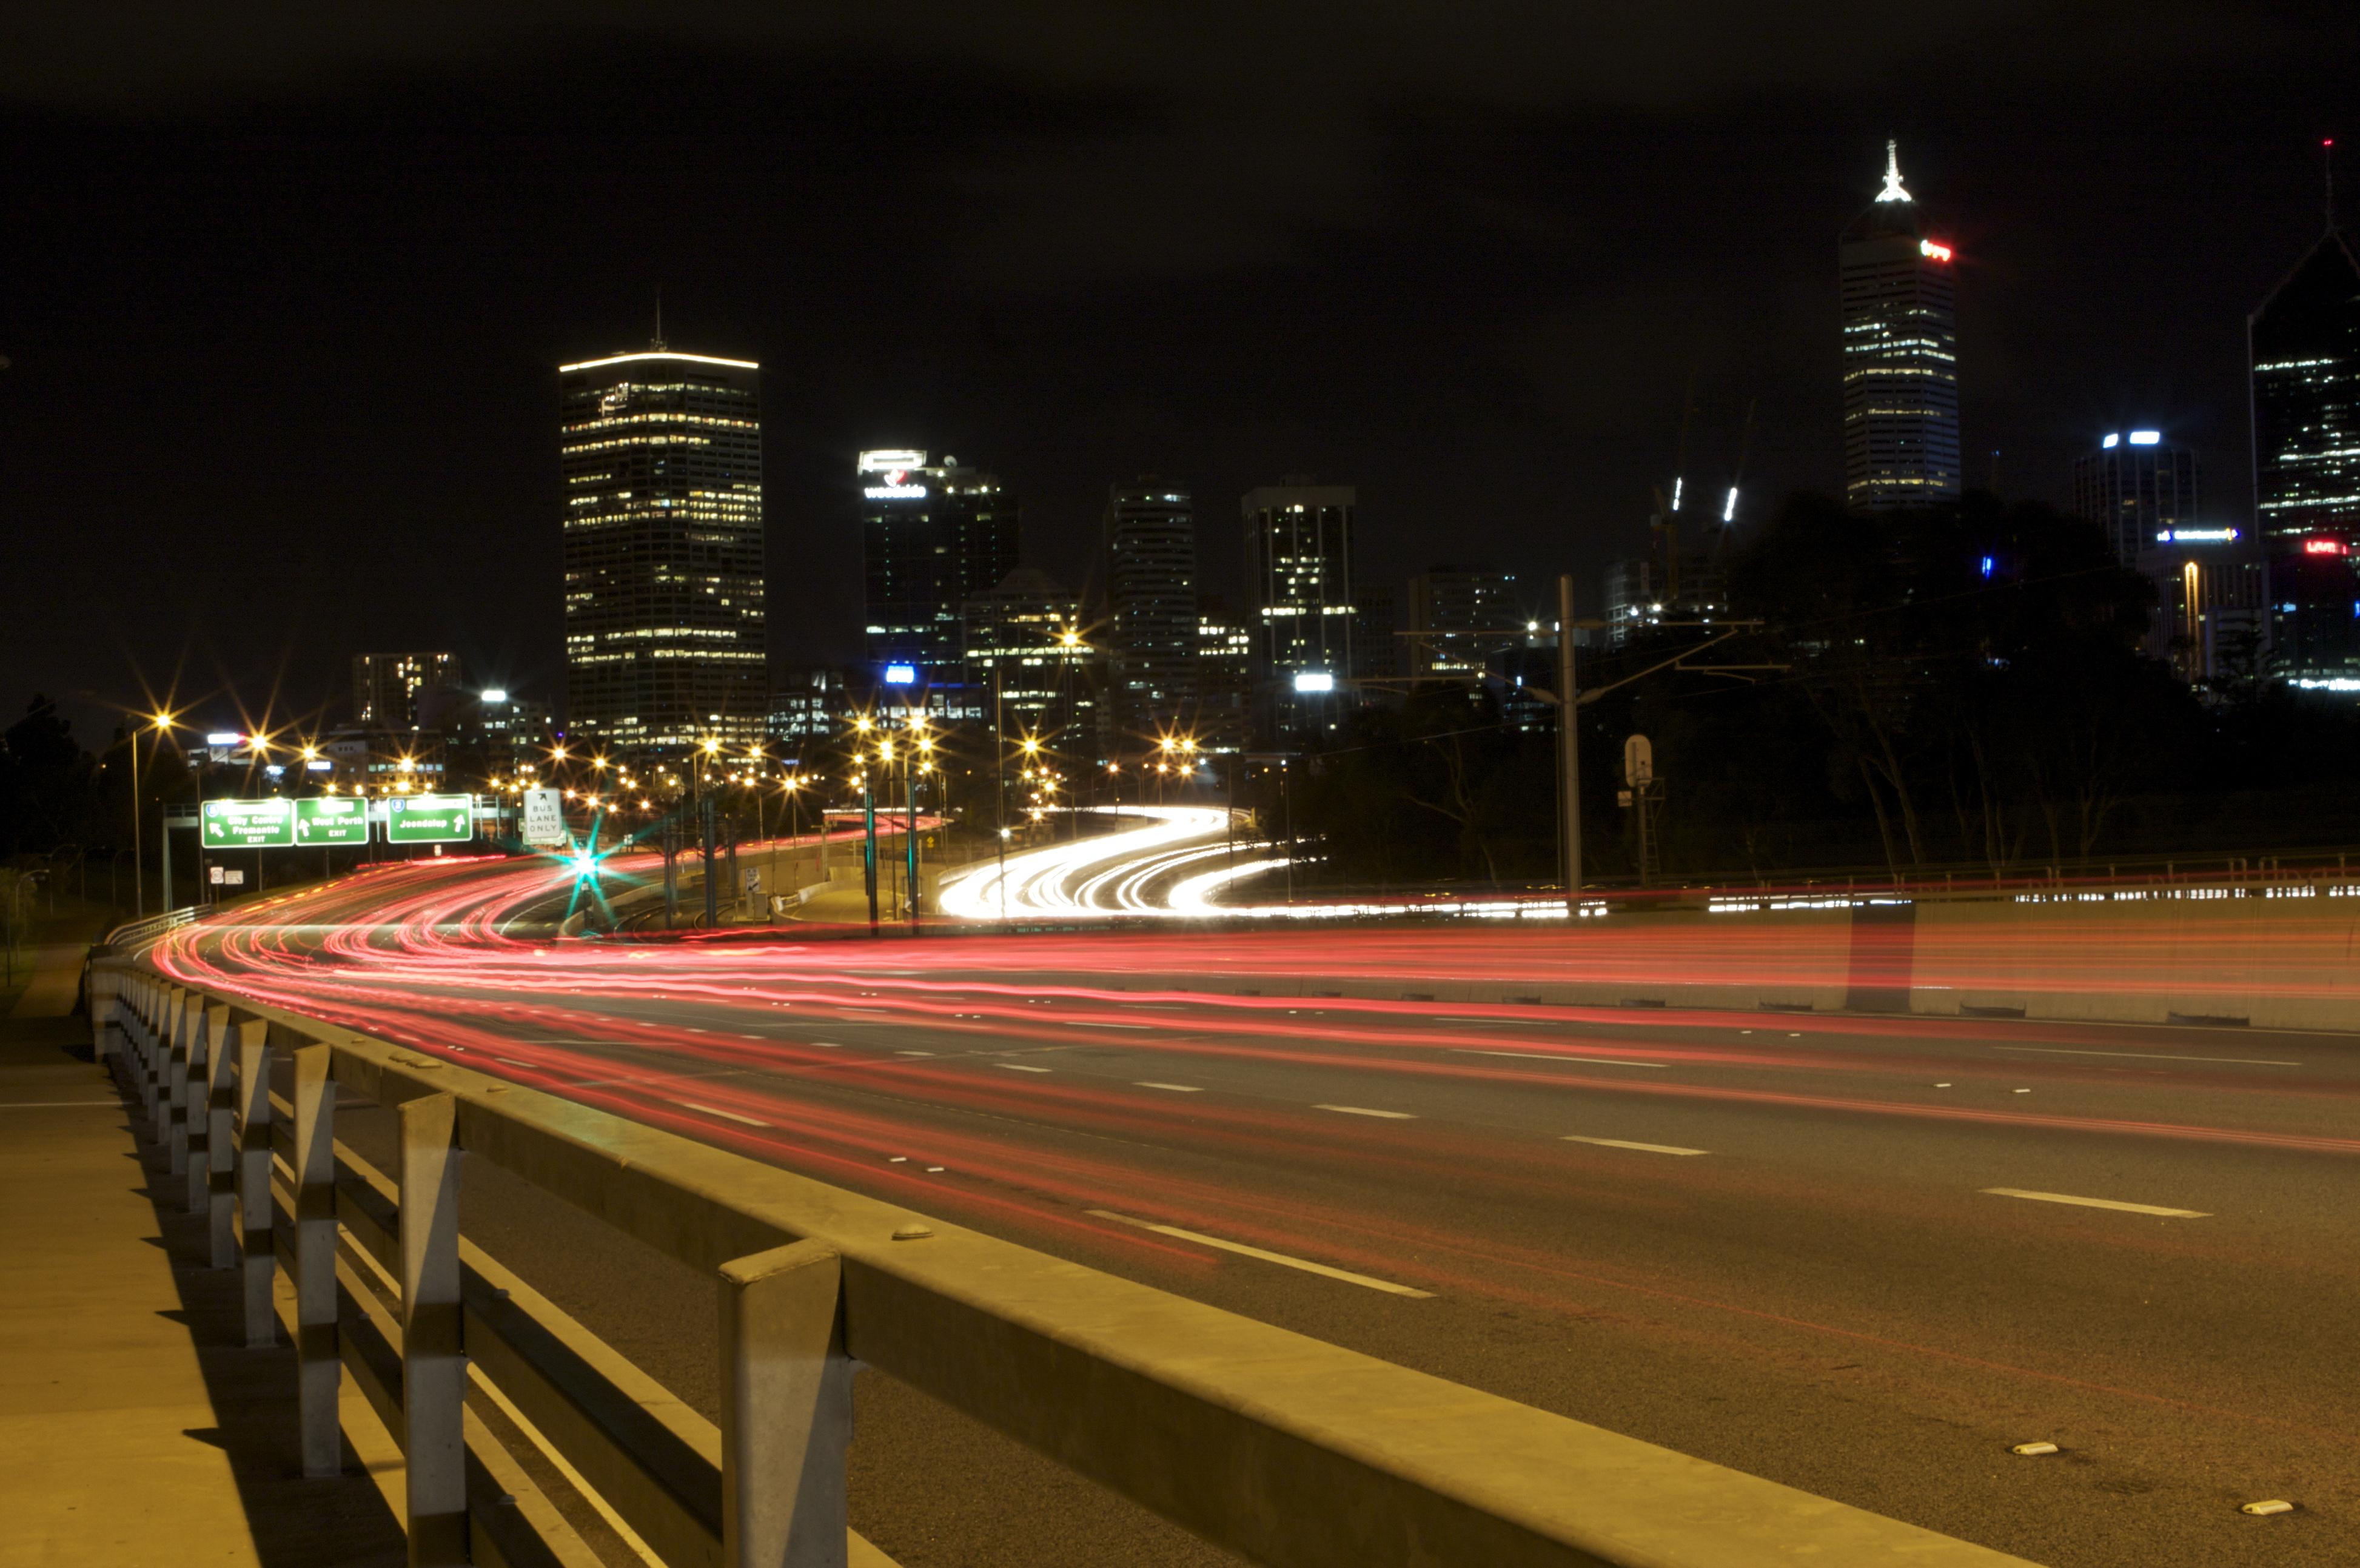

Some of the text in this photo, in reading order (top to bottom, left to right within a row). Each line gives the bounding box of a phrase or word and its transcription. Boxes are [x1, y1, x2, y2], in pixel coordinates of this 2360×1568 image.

[227, 816, 247, 826] City
[312, 816, 363, 826] West Perth
[400, 819, 448, 828] Joondalup
[233, 825, 280, 835] Fremantle
